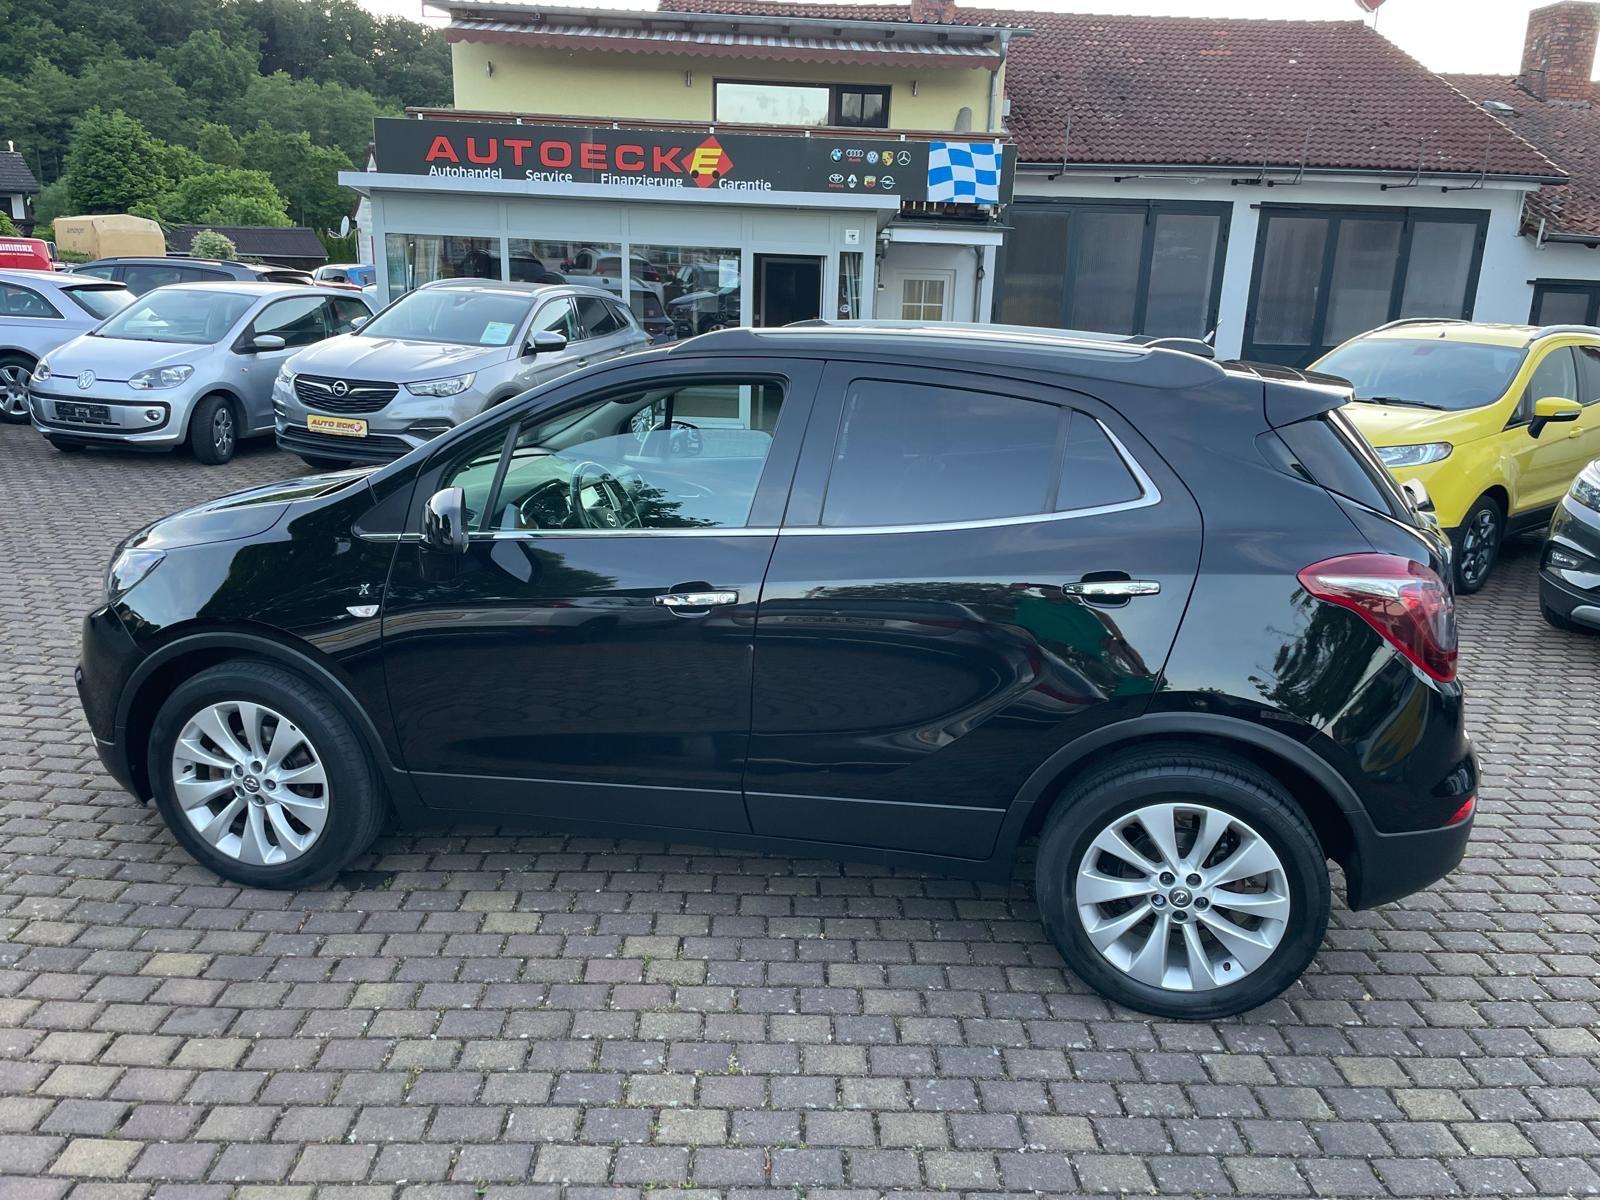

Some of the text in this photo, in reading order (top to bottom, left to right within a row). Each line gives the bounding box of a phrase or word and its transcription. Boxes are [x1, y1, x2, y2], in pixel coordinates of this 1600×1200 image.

[429, 165, 772, 191] Autohandel Service Finanzierung Garantie
[311, 419, 335, 427] AUTO
